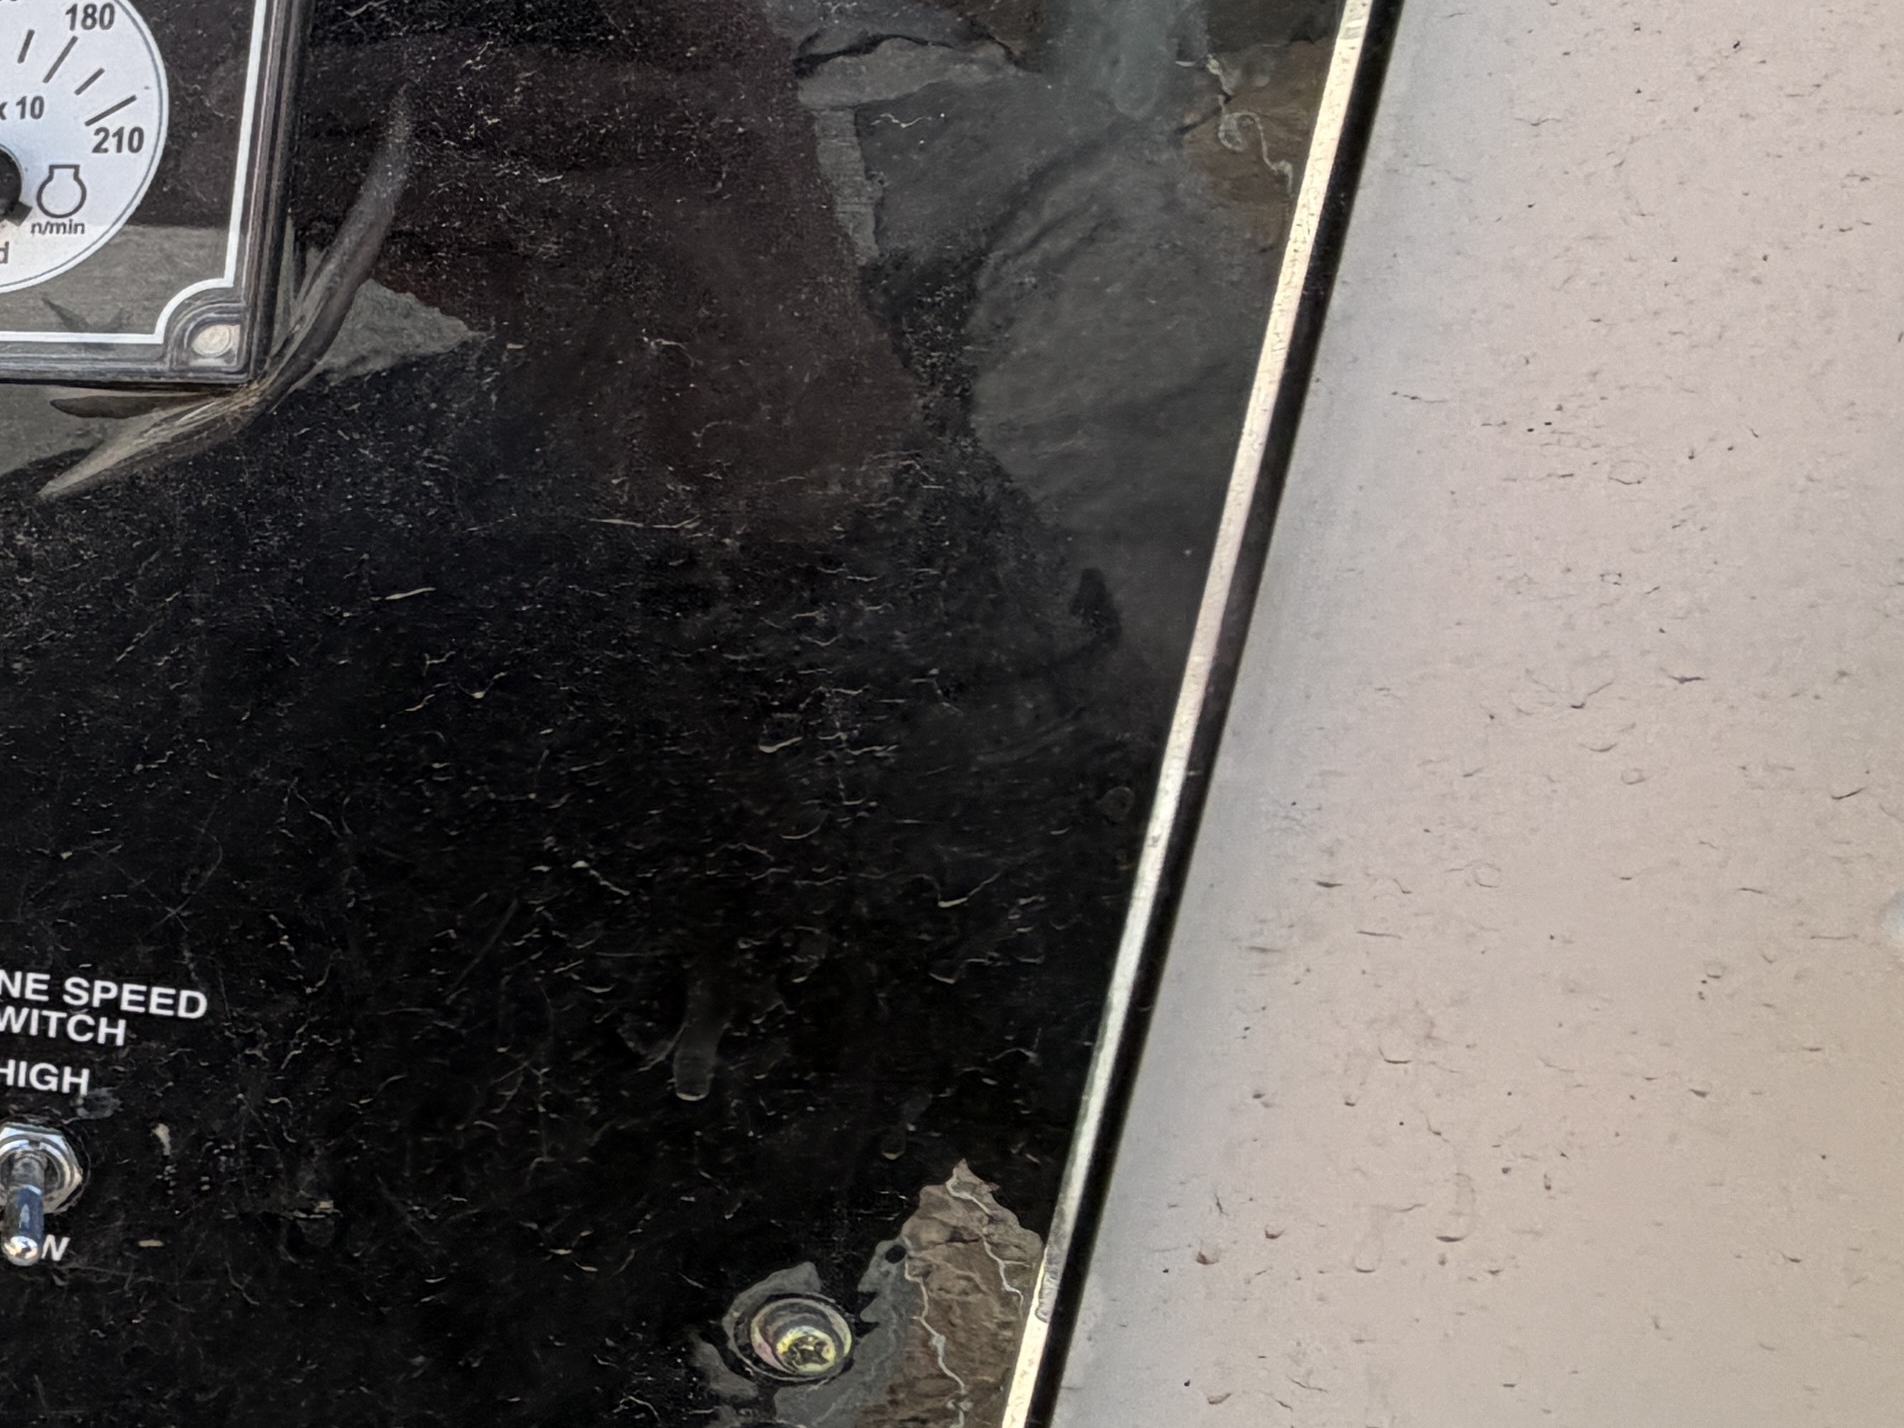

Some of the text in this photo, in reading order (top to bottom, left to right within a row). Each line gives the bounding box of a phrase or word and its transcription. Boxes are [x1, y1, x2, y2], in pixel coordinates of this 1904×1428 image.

[65, 3, 114, 31] 180
[16, 96, 44, 120] 10
[93, 126, 143, 153] 210
[31, 218, 86, 236] n/min
[64, 976, 209, 1020] SPEED
